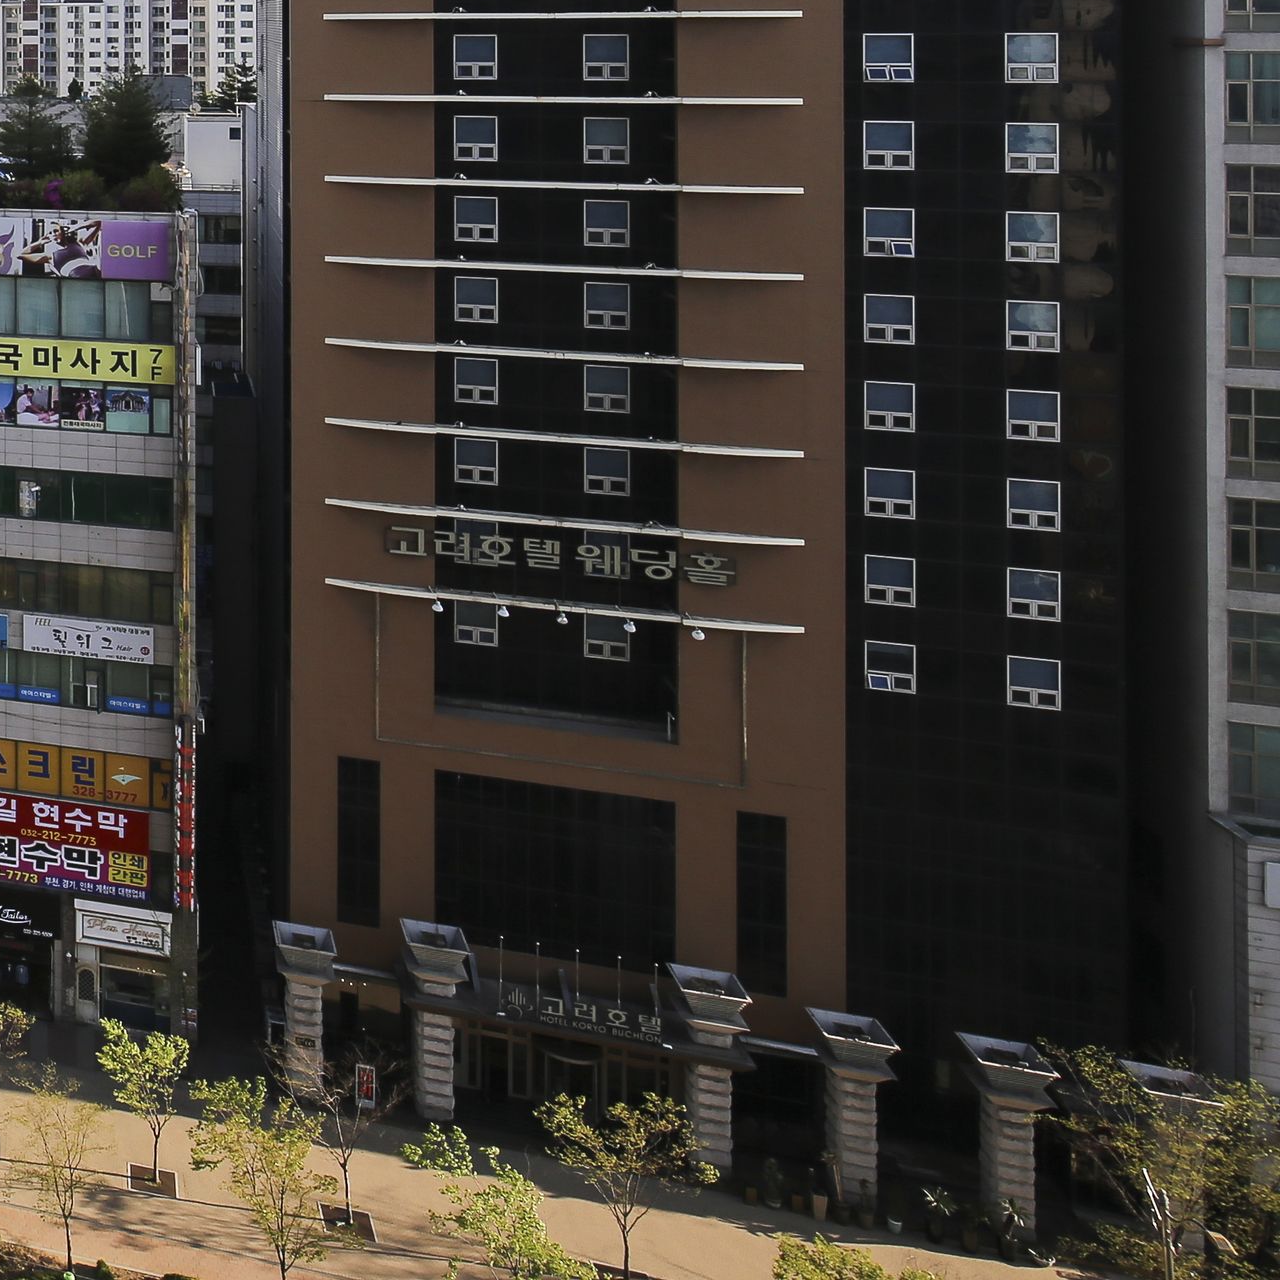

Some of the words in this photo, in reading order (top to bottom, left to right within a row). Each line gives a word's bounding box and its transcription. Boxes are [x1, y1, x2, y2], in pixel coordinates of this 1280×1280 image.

[107, 244, 160, 259] GOLF
[388, 524, 561, 571] 고려호텔
[575, 544, 736, 587] 웨딩홀
[32, 801, 128, 839] 현수막
[20, 828, 97, 846] 032-212-7773
[110, 851, 146, 870] 인쇄
[110, 869, 145, 886] 간판
[541, 996, 662, 1035] 고려호텔
[540, 1015, 569, 1027] HOTEL
[572, 1021, 607, 1034] KORYO
[612, 1028, 662, 1044] BUCHEON
